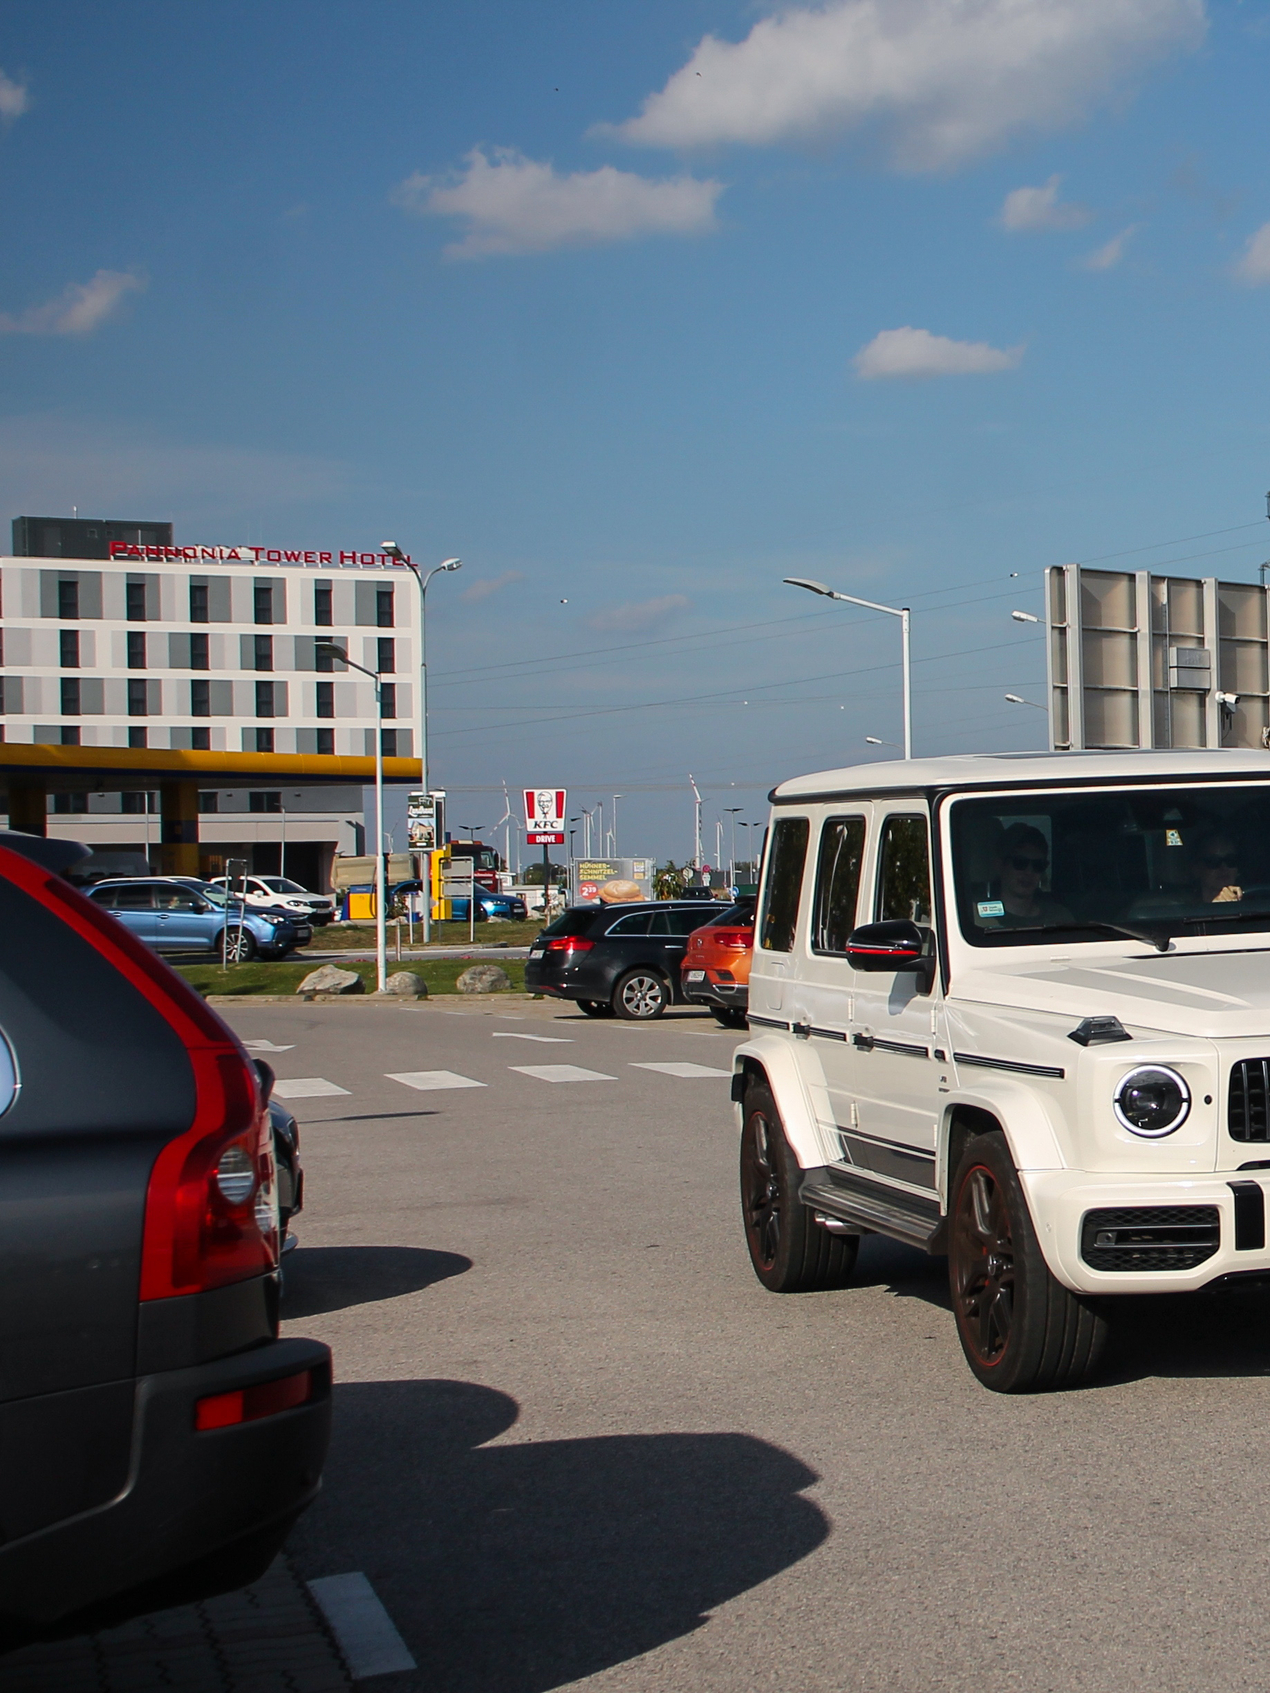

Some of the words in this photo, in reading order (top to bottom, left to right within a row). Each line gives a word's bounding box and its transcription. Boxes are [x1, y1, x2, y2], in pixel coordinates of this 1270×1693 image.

[109, 541, 240, 560] PANNONIA
[250, 547, 332, 564] TOWER
[339, 550, 418, 567] HOTEL
[533, 820, 559, 829] KFC
[535, 835, 556, 843] DRIVE
